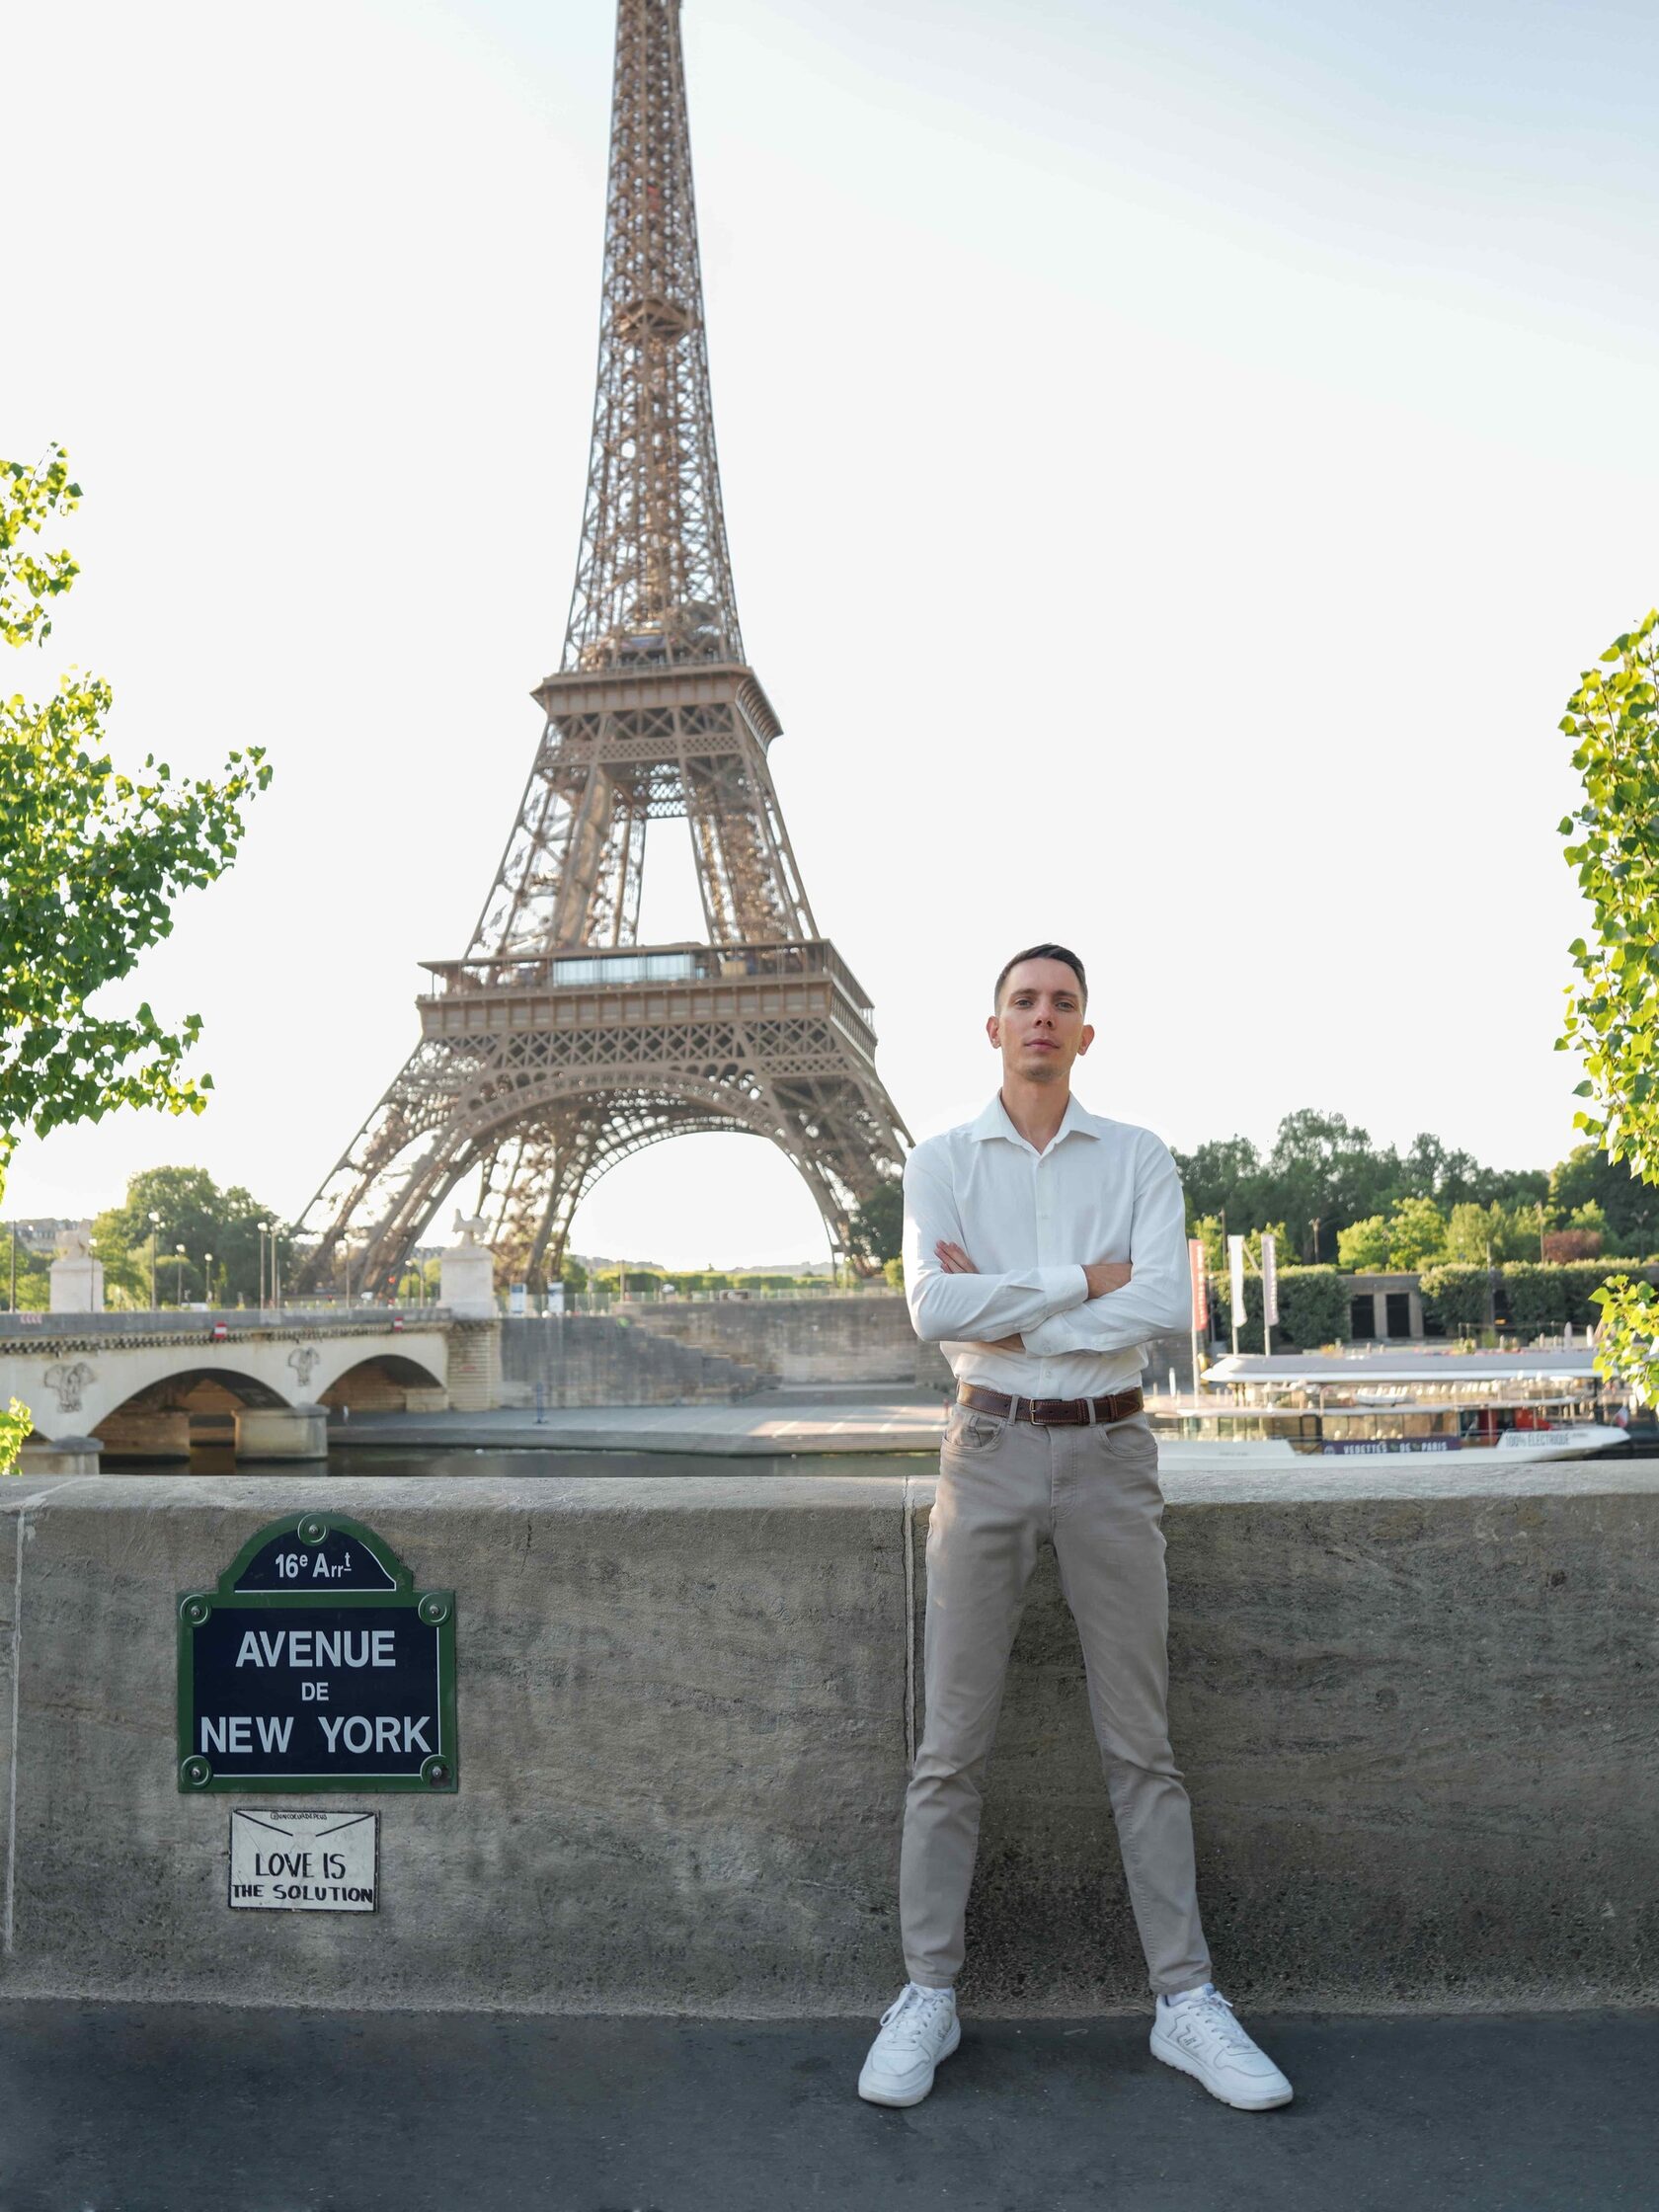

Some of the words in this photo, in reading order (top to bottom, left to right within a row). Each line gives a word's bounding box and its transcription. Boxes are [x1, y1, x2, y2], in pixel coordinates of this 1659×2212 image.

[1421, 1442, 1447, 1452] PARIS
[235, 1630, 396, 1668] AVENUE
[301, 1682, 330, 1701] DE
[200, 1716, 294, 1754] NEW
[318, 1715, 432, 1754] YORK
[255, 1853, 315, 1878] LOVE
[323, 1853, 346, 1879] IS
[232, 1884, 265, 1898] THE
[272, 1884, 373, 1903] SOLUTION
